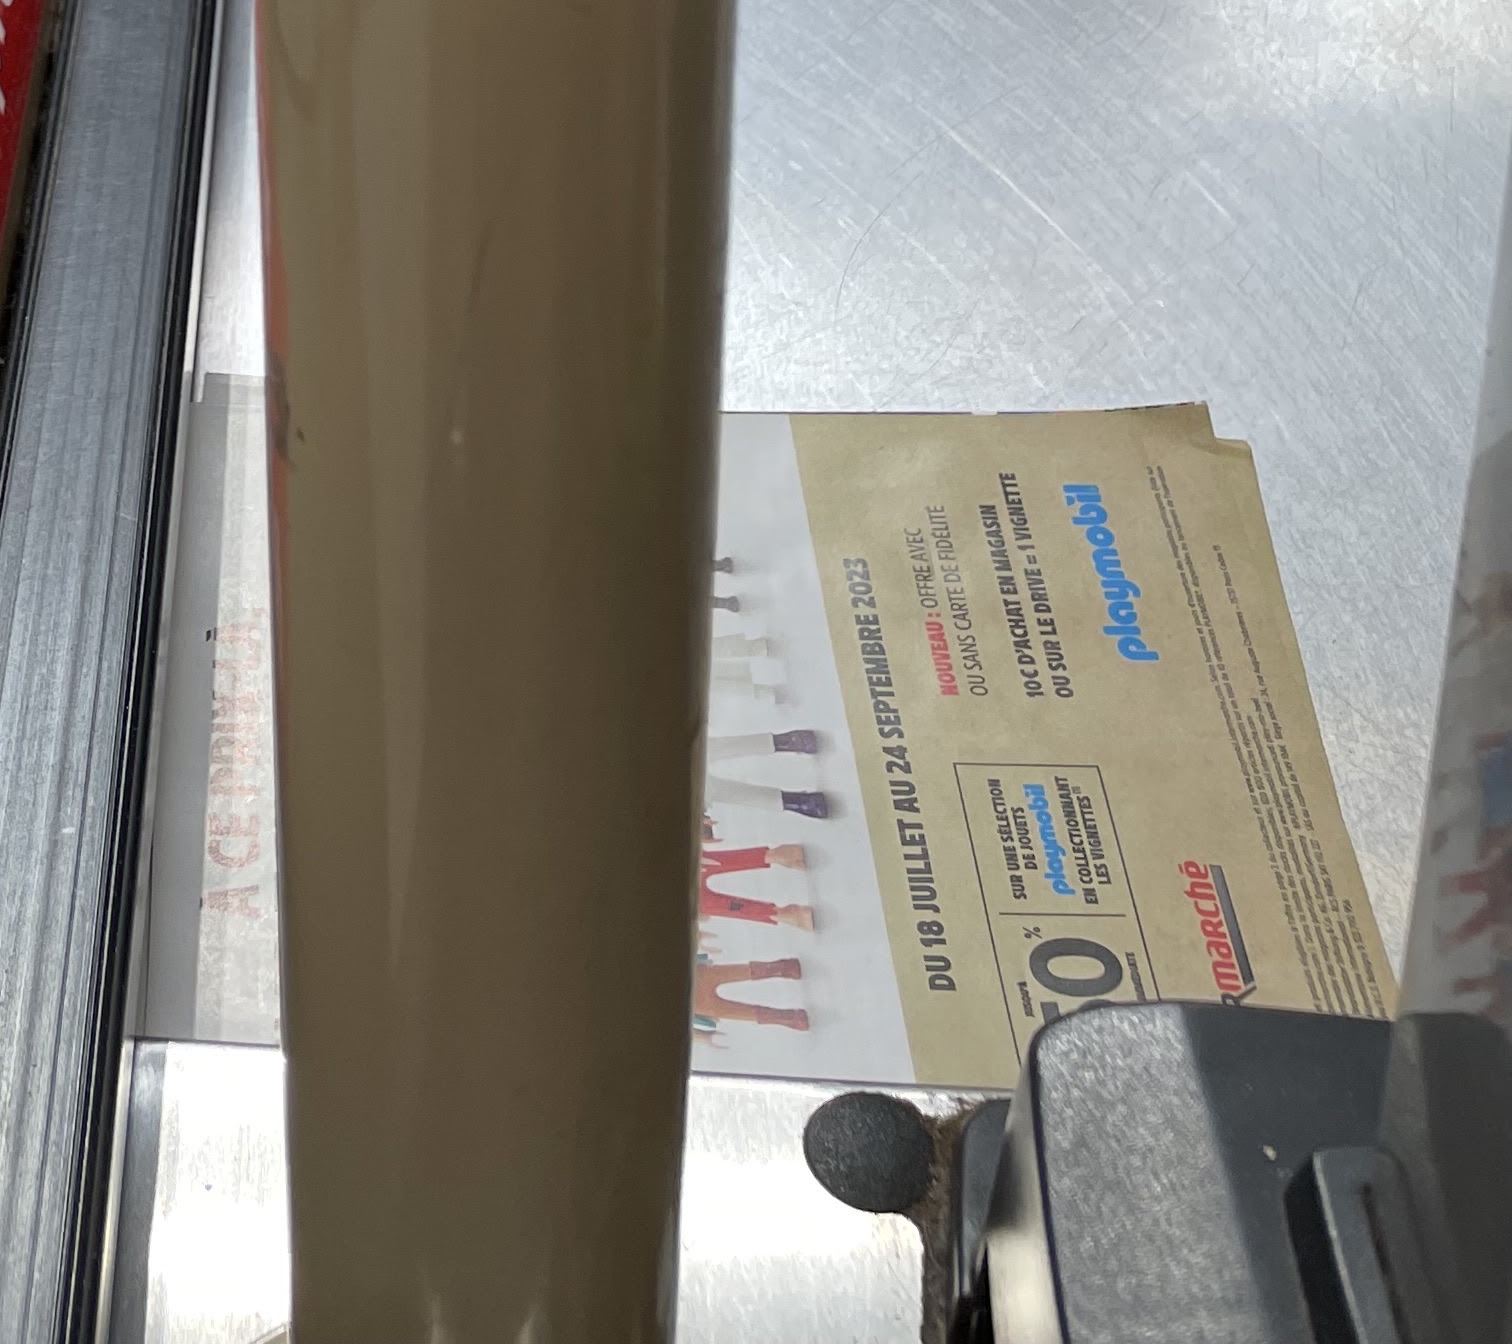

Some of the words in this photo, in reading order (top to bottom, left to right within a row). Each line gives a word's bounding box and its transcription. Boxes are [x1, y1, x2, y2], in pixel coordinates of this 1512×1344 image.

[999, 473, 1031, 540] VIGNETTE
[903, 527, 928, 562] AVEC
[926, 505, 955, 560] FIDÉLITÉ
[979, 504, 1011, 571] MAGASIN
[843, 558, 876, 608] 2023
[912, 565, 938, 608] OFFRE
[940, 564, 961, 583] DE
[997, 575, 1018, 595] EN
[1024, 568, 1051, 613] DRIVE
[1063, 484, 1159, 662] playmobil
[946, 587, 971, 630] CARTE
[1036, 617, 1057, 635] LE
[1003, 599, 1035, 664] D'ACHAT
[926, 621, 958, 695] NOUVEAU
[956, 634, 982, 670] SANS
[1042, 639, 1066, 671] SUR
[855, 614, 902, 738] SEPTEMBRE
[966, 674, 988, 696] OU
[1051, 675, 1073, 698] OU
[882, 745, 911, 774] 24
[889, 780, 920, 813] AU
[987, 778, 1013, 842] SÉLECTION
[207, 814, 260, 868] CE
[1010, 806, 1032, 850] JOUETS
[1024, 784, 1073, 894] playmobil
[1055, 777, 1092, 883] COLLECTIONNANT
[897, 819, 939, 912] JUILLET
[1002, 845, 1020, 871] UNE
[1021, 853, 1038, 870] DE
[1094, 863, 1111, 884] LES
[1009, 874, 1027, 899] SUR
[1082, 887, 1098, 904] EN
[916, 920, 946, 947] 18
[923, 954, 955, 991] DU
